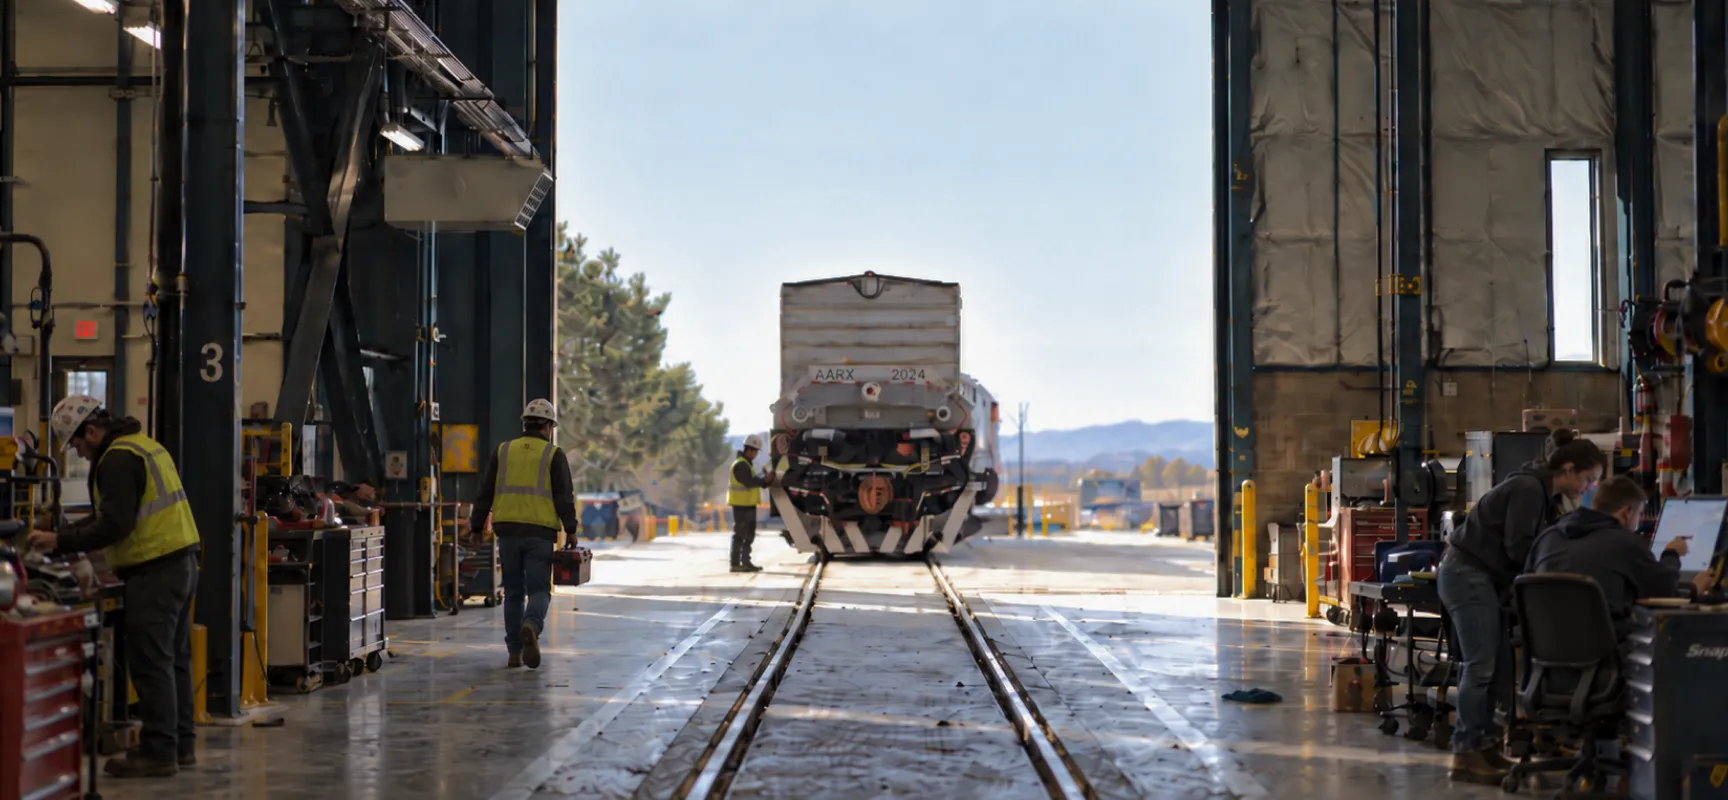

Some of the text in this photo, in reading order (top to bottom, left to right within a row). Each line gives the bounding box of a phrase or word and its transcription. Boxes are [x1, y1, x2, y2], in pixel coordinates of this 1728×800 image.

[200, 342, 223, 382] 3
[815, 368, 926, 381] AARX 2024
